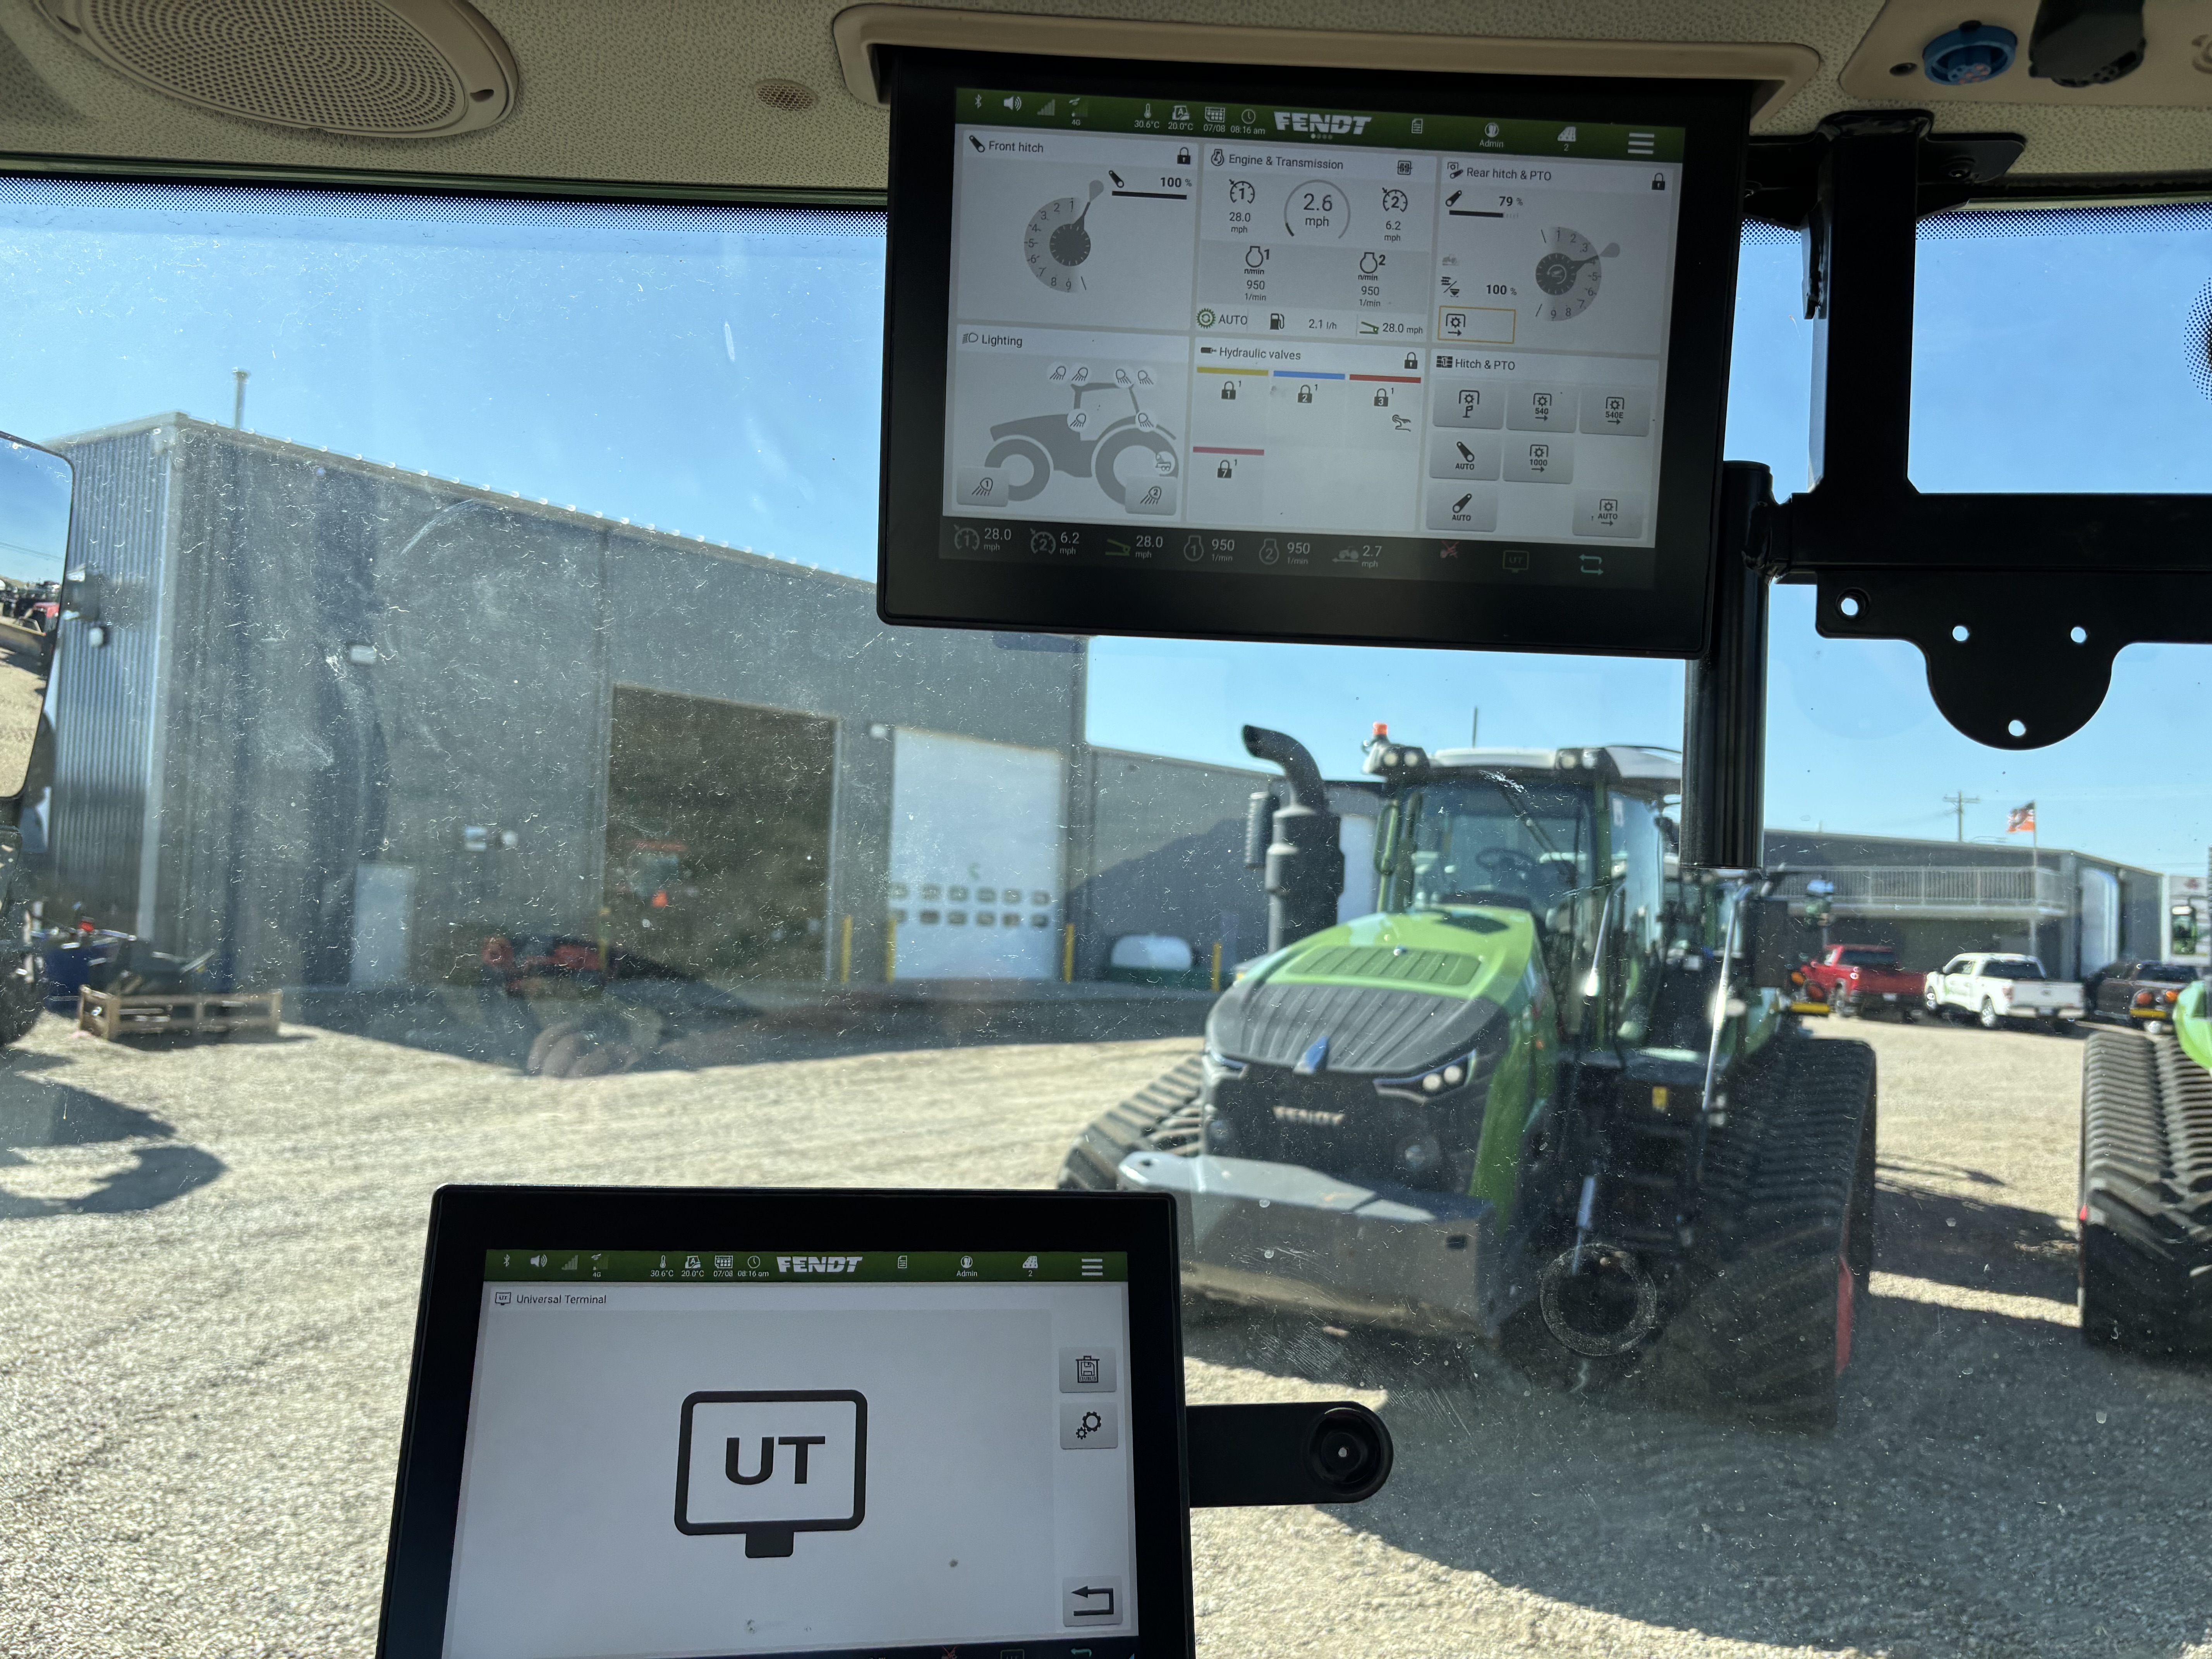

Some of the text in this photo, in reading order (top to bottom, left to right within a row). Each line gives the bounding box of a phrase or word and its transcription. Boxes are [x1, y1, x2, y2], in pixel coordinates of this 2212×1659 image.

[1274, 112, 1372, 135] FENDT
[1231, 126, 1251, 134] 08:16
[989, 141, 1043, 153] Front hitch
[1479, 139, 1503, 148] Admin
[1229, 155, 1343, 169] Engine & Transmission
[1467, 168, 1551, 181] Rear hitch & PTO
[1161, 178, 1182, 187] 100
[1304, 194, 1333, 211] 2.6
[1499, 196, 1513, 206] 79
[1054, 204, 1060, 212] 2
[1041, 211, 1046, 220] 3
[1230, 213, 1250, 222] 28.0
[1305, 217, 1329, 228] mph
[1386, 221, 1401, 230] 6.2
[1032, 224, 1037, 232] 4
[1029, 239, 1034, 247] 5
[1571, 234, 1576, 242] 2
[1030, 255, 1036, 263] 6
[1264, 249, 1270, 259] 1
[1379, 255, 1385, 266] 2
[1051, 277, 1056, 286] 8
[1592, 272, 1597, 281] 5
[1066, 281, 1071, 289] 9
[1247, 280, 1265, 290] 950
[1487, 285, 1507, 295] 100
[1361, 287, 1379, 296] 950
[1245, 293, 1266, 301] 1/min
[1551, 310, 1556, 318] 9
[1566, 308, 1571, 316] 8
[1219, 315, 1248, 325] AUTO
[1309, 319, 1323, 329] 2.1
[1382, 323, 1403, 333] 28.0
[982, 335, 1022, 348] Lighting
[1219, 347, 1301, 361] Hydraulic valves
[1456, 359, 1515, 370] Hitch & PTO
[985, 528, 1011, 541] 28.0
[1061, 532, 1079, 544] 6.2
[1136, 535, 1163, 548] 28.0
[1212, 539, 1235, 551] 950
[984, 543, 1000, 552] mph
[1060, 547, 1076, 556] mph
[1288, 543, 1310, 554] 950
[1363, 546, 1382, 556] 2.7
[1135, 551, 1151, 559] mph
[1362, 560, 1378, 568] mph
[777, 1256, 862, 1273] FENDT
[517, 1295, 606, 1304] Universal Terminal
[726, 1436, 825, 1485] UT
